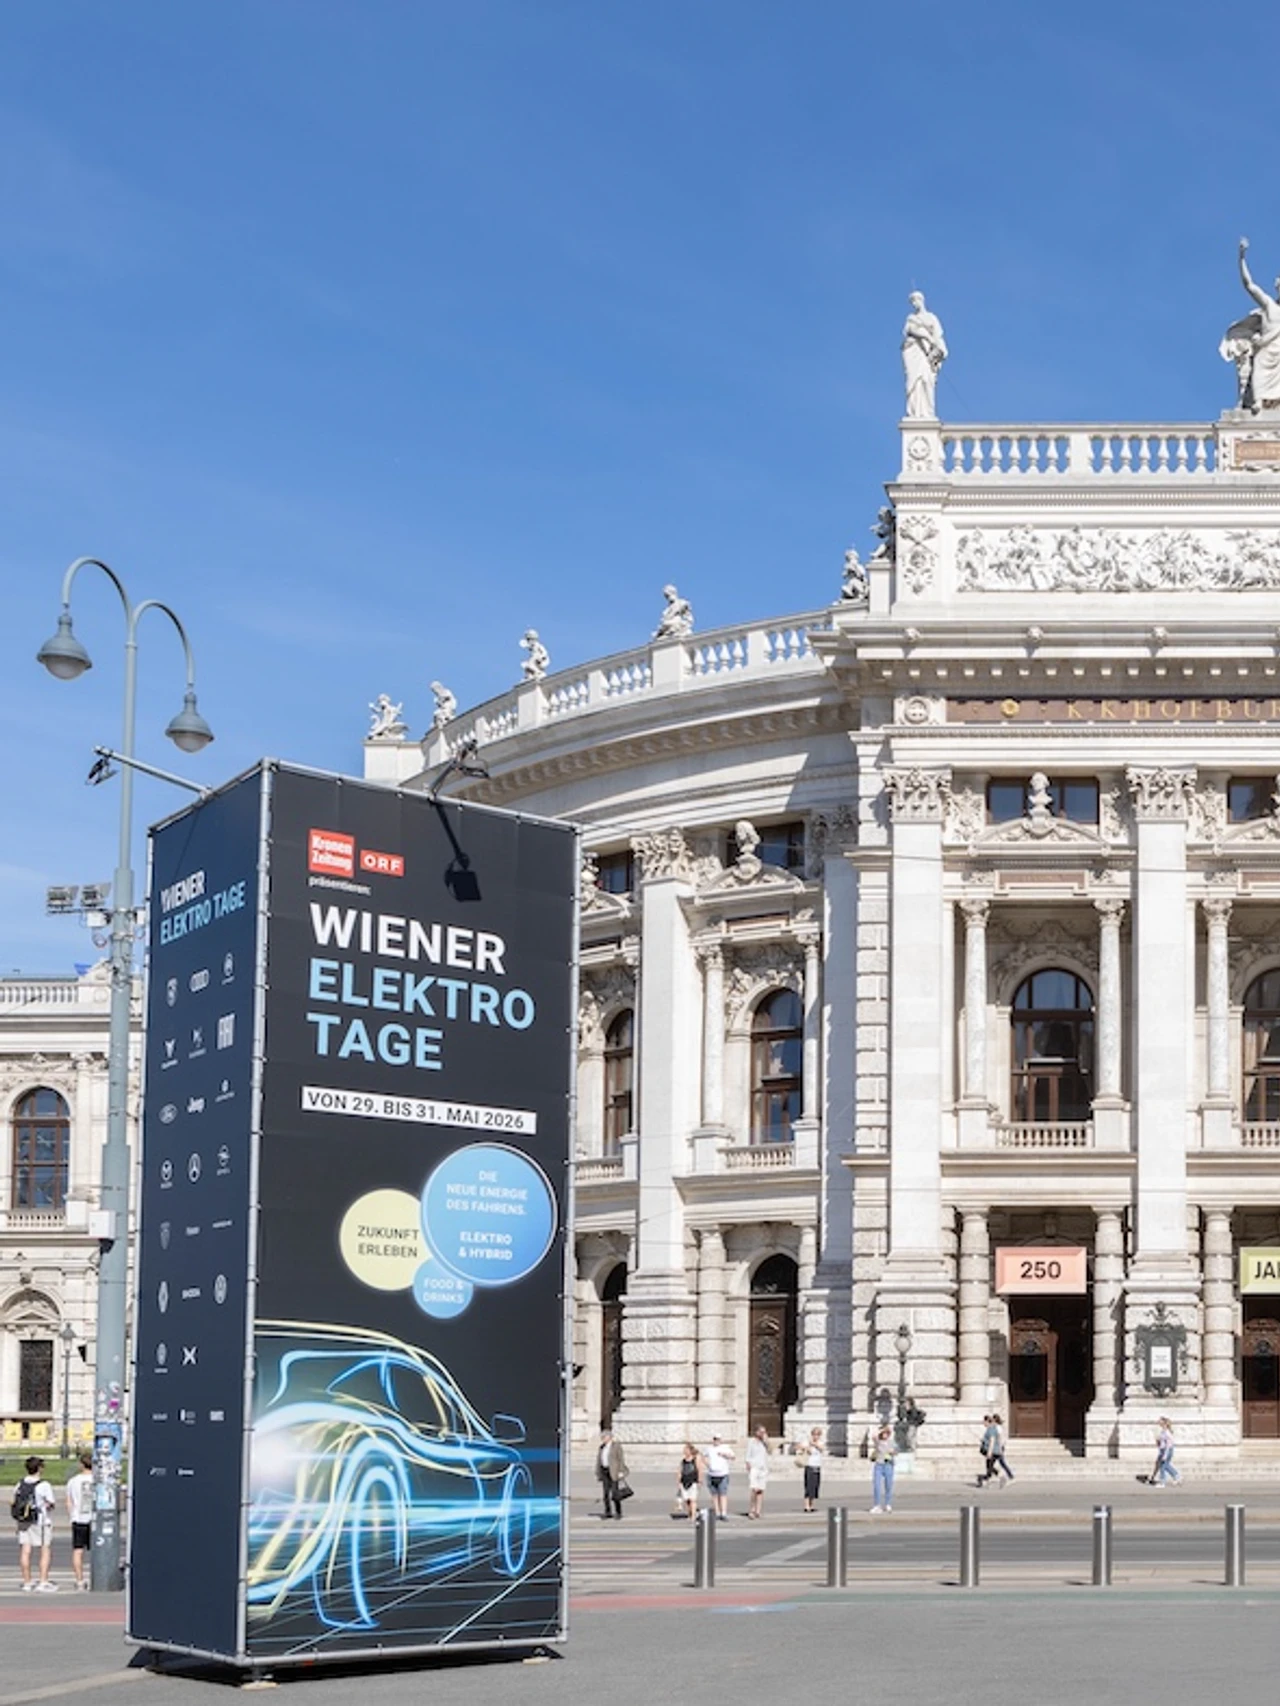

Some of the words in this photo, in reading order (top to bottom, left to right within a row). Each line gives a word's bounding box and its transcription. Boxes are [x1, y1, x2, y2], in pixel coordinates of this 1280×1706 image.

[364, 854, 401, 871] ORF
[161, 870, 205, 914] WIENER
[160, 899, 212, 946] ELEKTRO
[213, 881, 247, 919] TAGE
[309, 902, 506, 975] WIENER
[309, 957, 535, 1030] ELEKTRO
[306, 1012, 443, 1070] TAGE
[307, 1090, 347, 1110] VON
[352, 1097, 379, 1113] 29.
[383, 1102, 412, 1118] BIS
[416, 1105, 442, 1120] 31.
[446, 1107, 479, 1124] MAI
[484, 1111, 524, 1129] 2026
[478, 1170, 498, 1183] DIE
[446, 1183, 477, 1196] NEUE
[479, 1185, 528, 1199] ENERGIE
[446, 1199, 469, 1211] DES
[471, 1201, 527, 1215] FAHRENS.
[357, 1225, 419, 1241] ZUKUNFT
[459, 1231, 513, 1246] ELEKTRO
[358, 1244, 418, 1258] ERLEBEN
[458, 1247, 468, 1258] &
[470, 1247, 513, 1261] HYBRID
[1018, 1261, 1061, 1279] 250
[423, 1278, 454, 1289] FOOD
[455, 1278, 464, 1289] &
[422, 1291, 465, 1304] DRINKS
